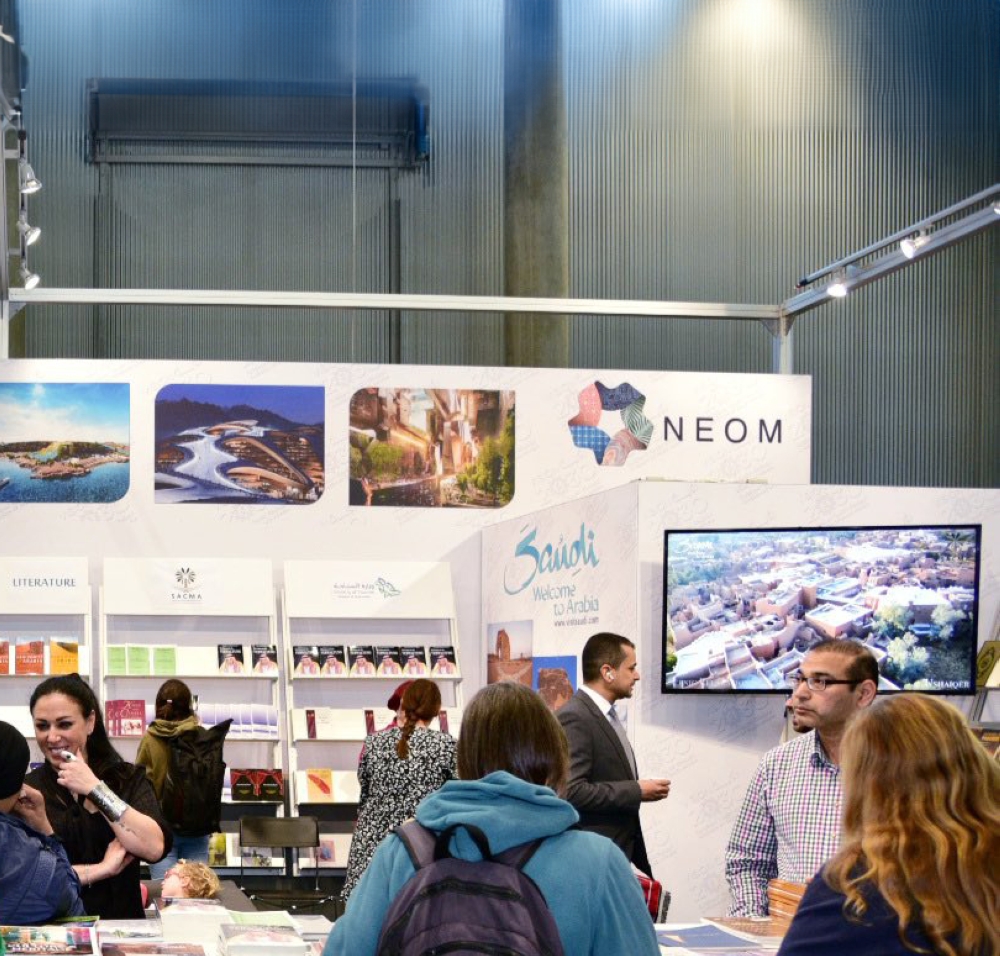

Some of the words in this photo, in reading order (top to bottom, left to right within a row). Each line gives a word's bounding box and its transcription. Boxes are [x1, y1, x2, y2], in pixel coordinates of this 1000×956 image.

[664, 416, 782, 443] NEOM
[13, 578, 77, 587] LITERATURE
[533, 584, 576, 601] Welcome
[554, 603, 565, 616] to
[567, 595, 599, 616] Arabia
